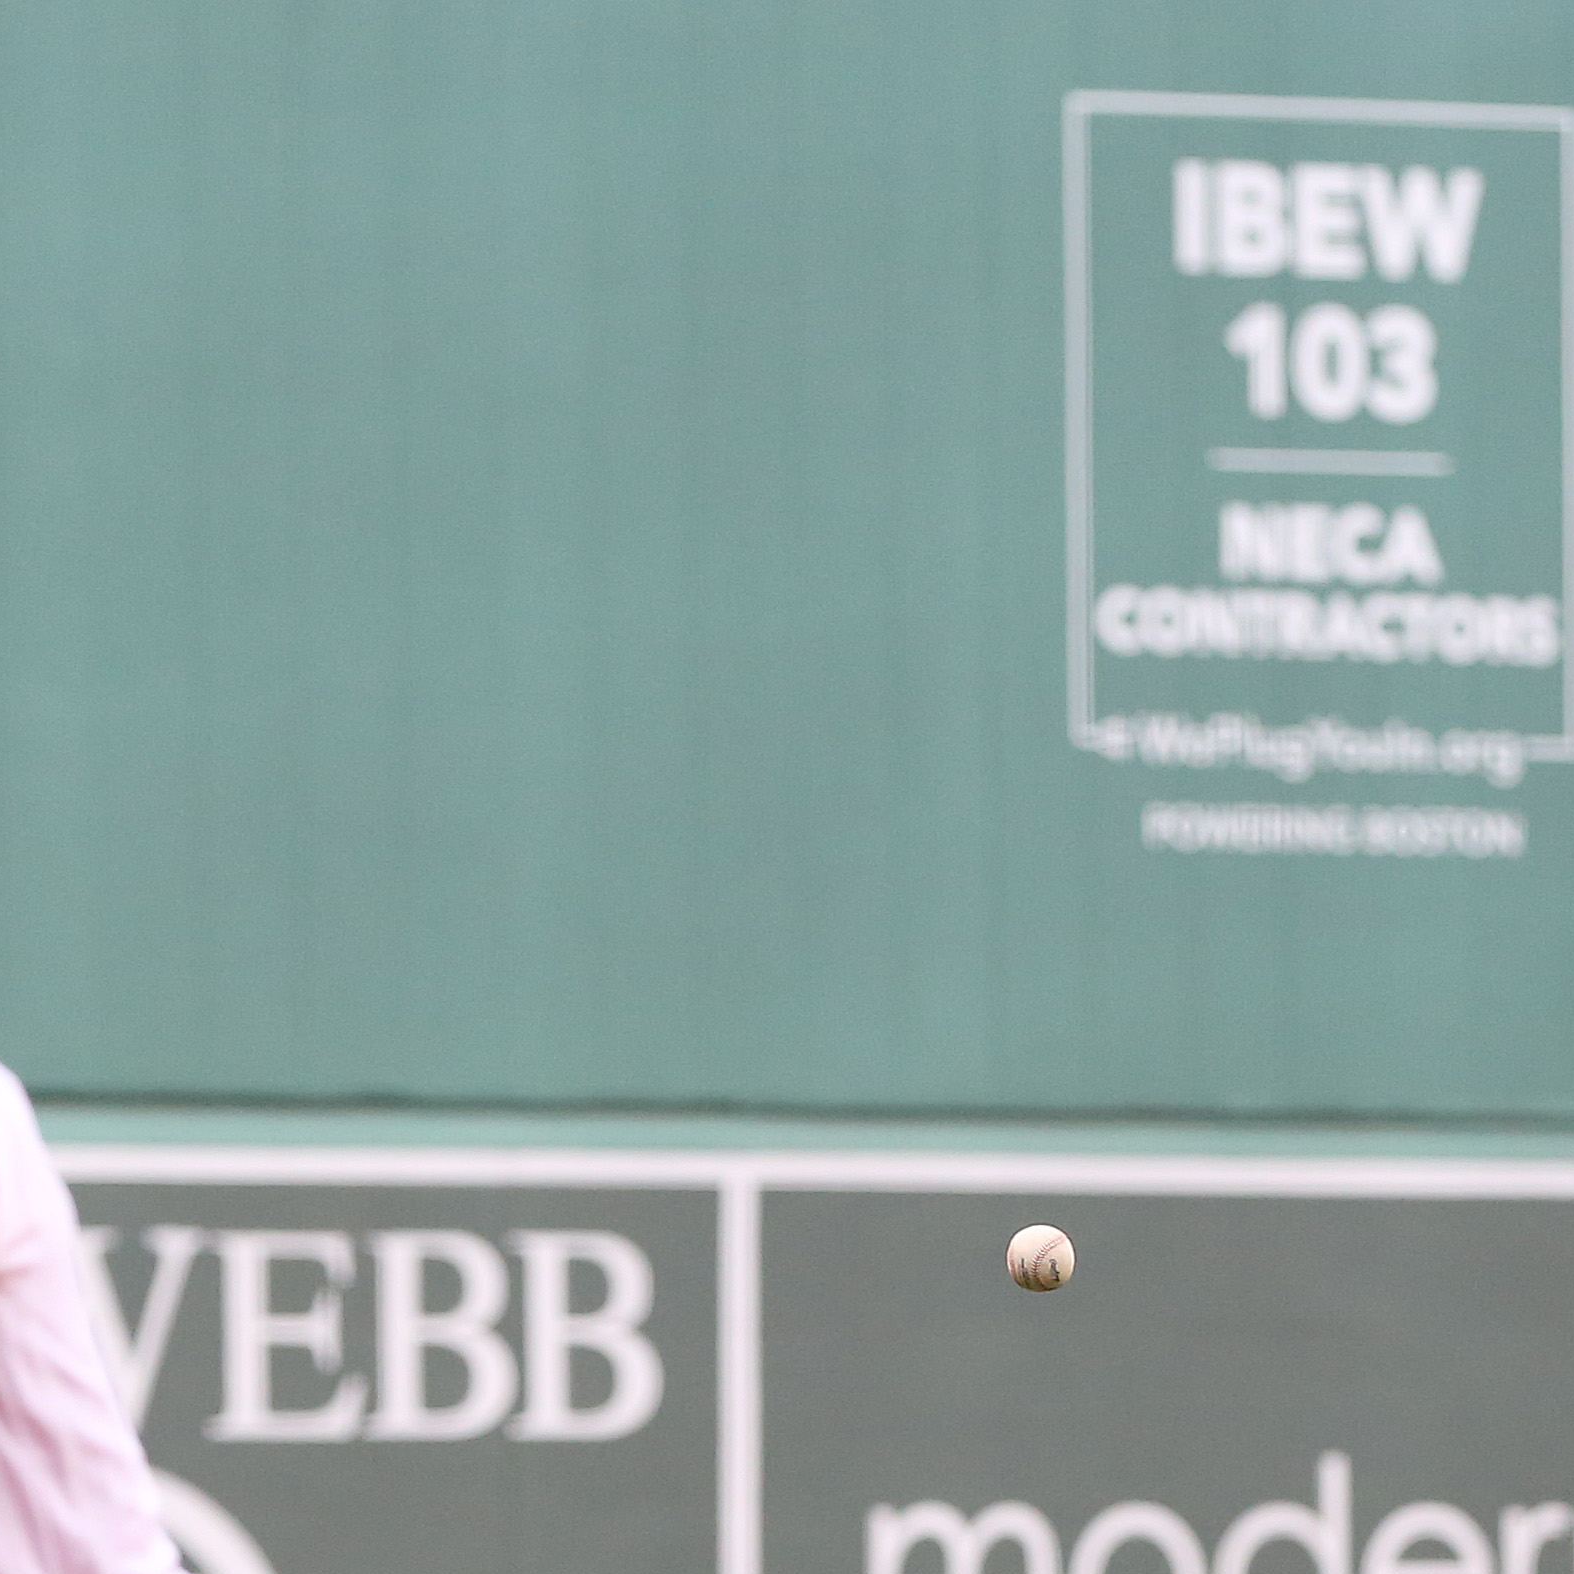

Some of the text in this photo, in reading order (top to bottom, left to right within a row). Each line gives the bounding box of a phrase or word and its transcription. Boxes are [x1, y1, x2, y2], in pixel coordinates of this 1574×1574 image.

[1173, 157, 1485, 284] IBEW
[1226, 302, 1439, 425] 103
[1218, 503, 1444, 585] NECA
[1096, 584, 1562, 668] CONTRACTORS
